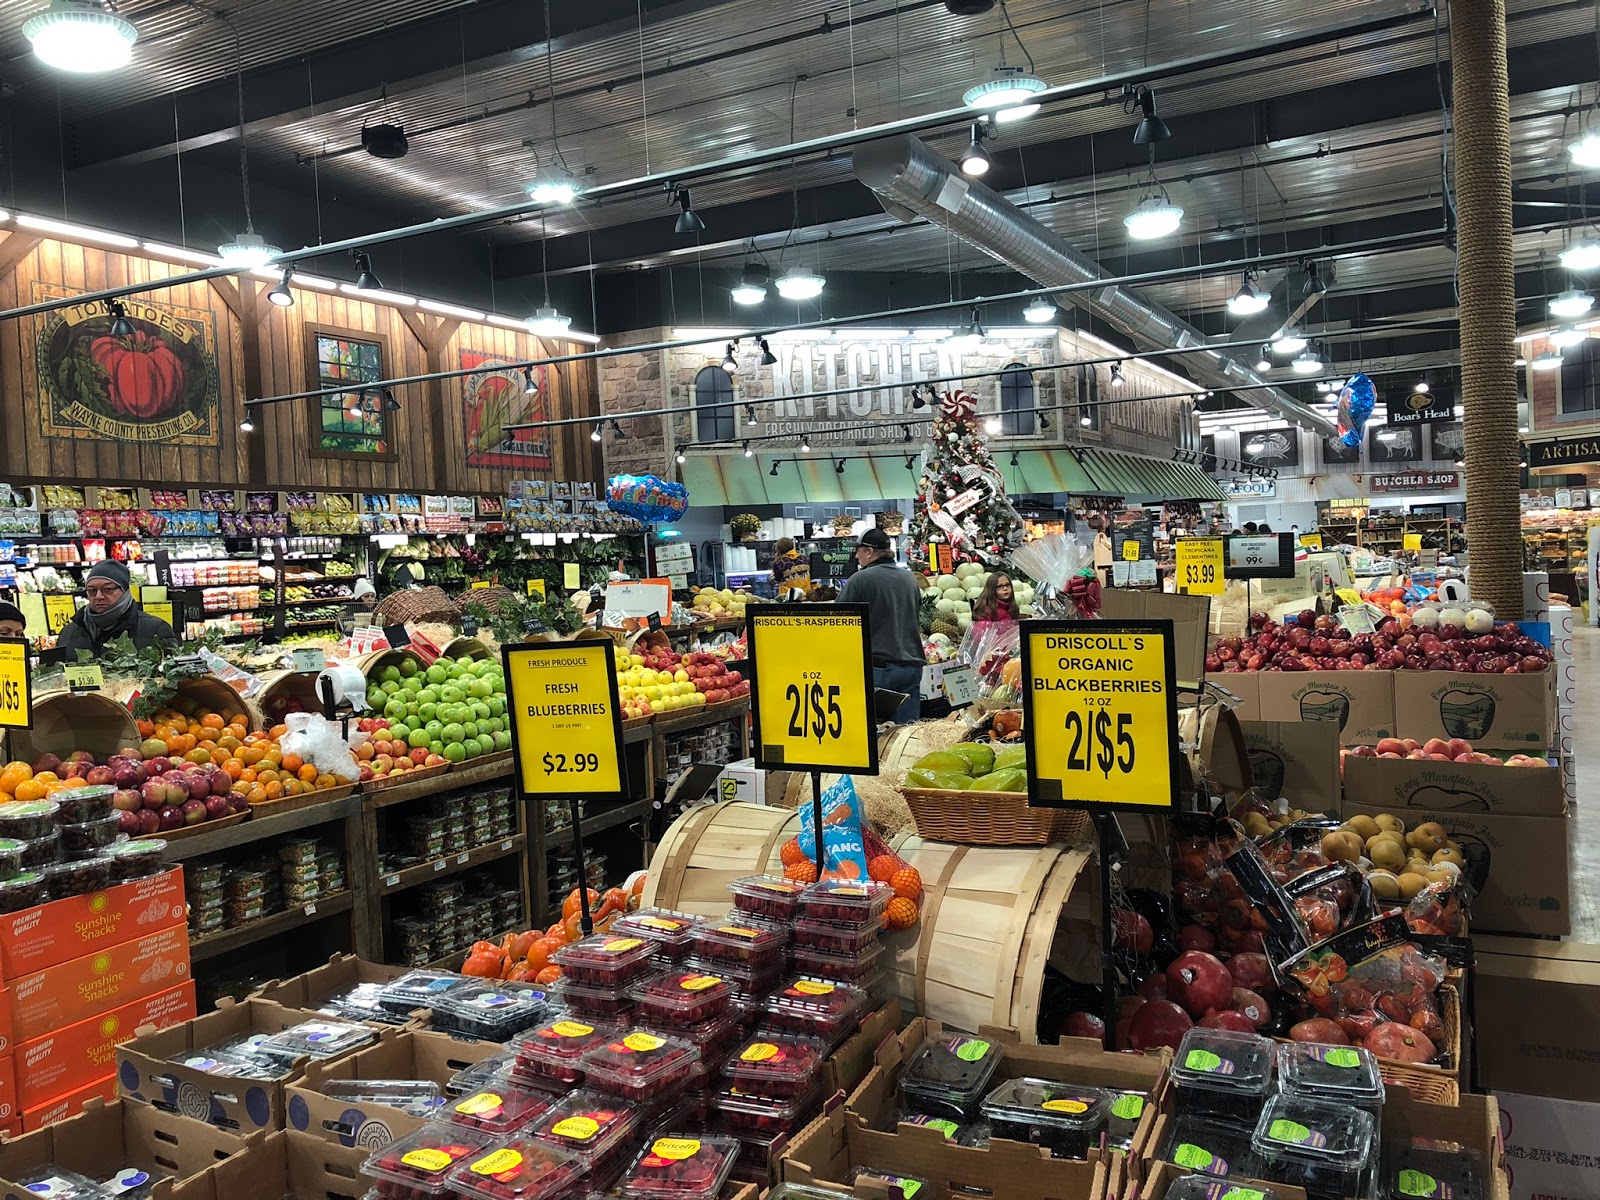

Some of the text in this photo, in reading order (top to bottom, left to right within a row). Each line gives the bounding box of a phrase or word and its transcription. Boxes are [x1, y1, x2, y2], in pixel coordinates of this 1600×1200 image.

[771, 343, 963, 418] KITCHEN
[70, 401, 102, 429] WAYNE
[103, 420, 133, 439] COUNTY
[136, 420, 183, 439] PRESERVING
[1393, 409, 1450, 422] Boar's Head
[765, 421, 812, 442] FRESHLY
[818, 421, 874, 440] PREPARED
[527, 444, 545, 455] CORN
[1186, 564, 1215, 586] $3.99
[755, 618, 862, 627] RISCOLL'S-RASPBERRIE
[528, 657, 587, 667] FRESH PRODUCE
[1058, 658, 1134, 671] ORGANIC
[545, 683, 578, 694] FRESH
[1034, 678, 1162, 693] BLACKBERRIES
[1449, 681, 1485, 691] Mountain
[527, 703, 606, 717] BLUEBERRIES
[1083, 698, 1112, 706] 12 OZ
[785, 680, 843, 745] 2/$5
[1064, 707, 1136, 780] 2/$5
[542, 751, 599, 776] $2.99
[1421, 771, 1476, 787] Mountain
[12, 909, 43, 928] PREMIUM
[13, 918, 40, 936] QUALITY
[75, 911, 122, 933] Sunshine
[81, 923, 116, 942] Snacks
[15, 973, 45, 992] PREMIUM
[17, 983, 44, 1000] QUALITY
[78, 970, 125, 995] Sunshine
[84, 984, 119, 1003] Snacks
[25, 1038, 54, 1058] PREMIUM
[27, 1047, 52, 1067] QUALITY
[93, 1051, 117, 1067] Snac
[41, 1101, 69, 1123] PREMIUM
[361, 1126, 389, 1144] naturipe
